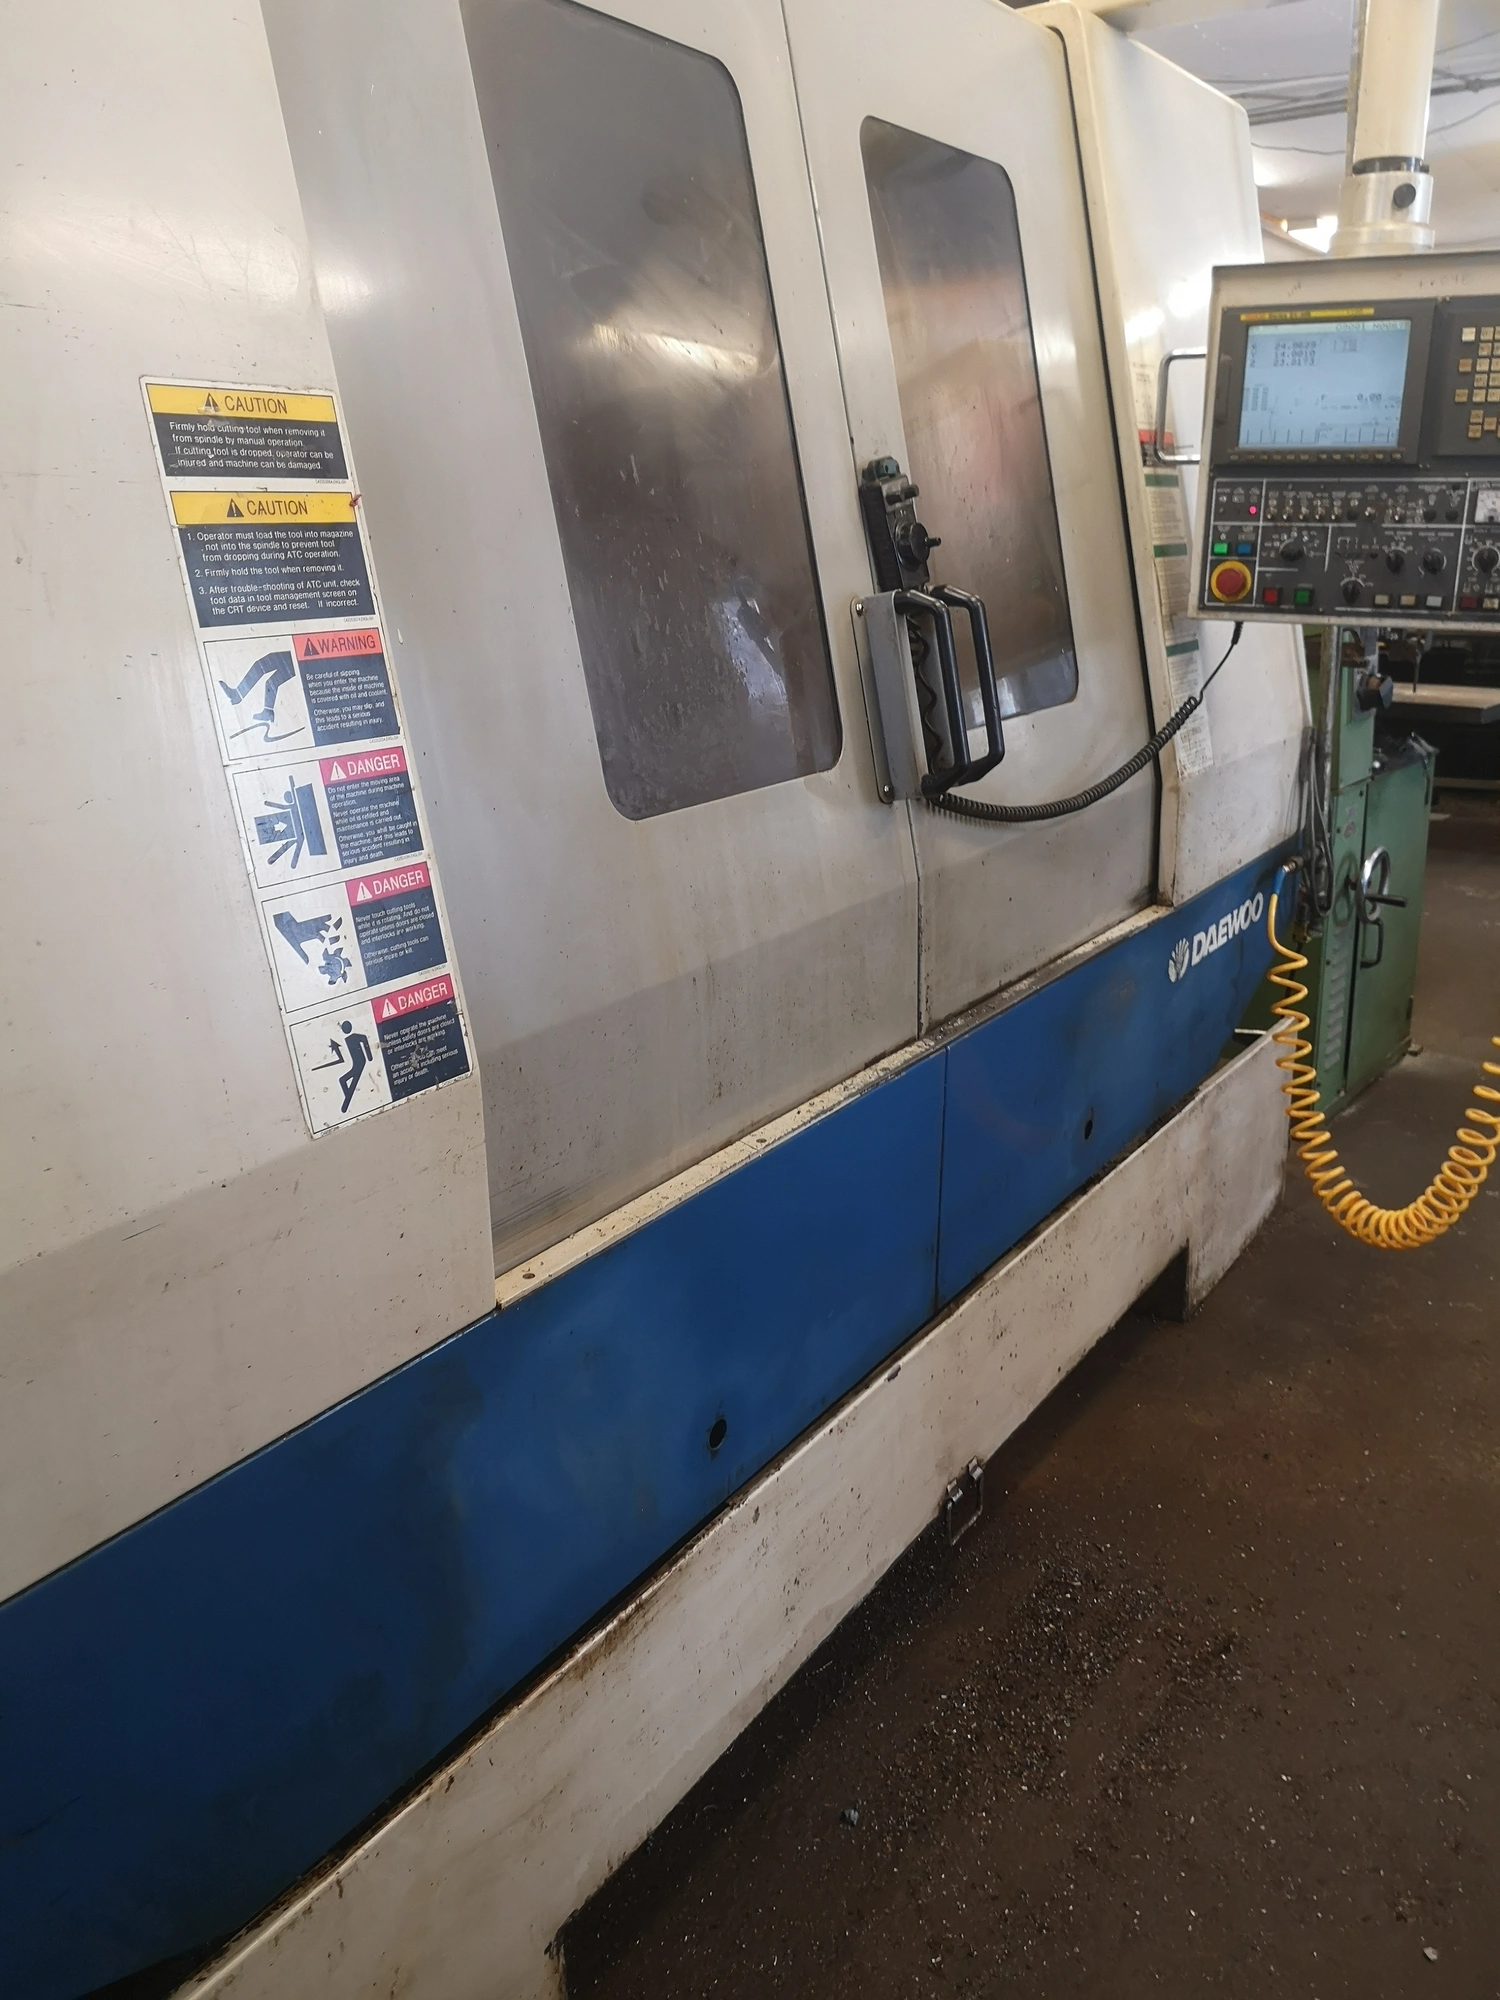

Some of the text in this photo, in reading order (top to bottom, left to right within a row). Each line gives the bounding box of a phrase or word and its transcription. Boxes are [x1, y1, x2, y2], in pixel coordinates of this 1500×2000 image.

[225, 396, 288, 414] CAUTION
[169, 422, 196, 432] Firmly
[197, 423, 216, 431] hold
[217, 424, 245, 434] cutting
[284, 428, 319, 438] removing
[172, 434, 306, 448] from spindle by manual operation.
[174, 446, 182, 454] If
[183, 447, 212, 456] cutting
[231, 448, 238, 456] is
[275, 450, 308, 459] operator
[177, 458, 207, 468] injured
[208, 459, 224, 467] and
[225, 459, 259, 467] machine
[287, 461, 323, 471] damaged.
[247, 500, 308, 516] CAUTION
[187, 533, 195, 541] 1.
[196, 532, 234, 542] Operator
[235, 532, 254, 540] must
[274, 531, 287, 539] the
[320, 530, 354, 539] magazine
[204, 543, 219, 551] not
[220, 542, 237, 550] into
[238, 542, 251, 550] the
[252, 541, 280, 551] spindle
[290, 540, 320, 549] prevent
[223, 552, 259, 562] dropping
[260, 551, 285, 561] during
[304, 550, 341, 559] operation.
[204, 569, 230, 579] Firmly
[231, 568, 249, 576] hold
[250, 567, 263, 575] the
[280, 566, 301, 574] when
[302, 564, 336, 574] removing
[198, 587, 207, 595] 3.
[208, 586, 229, 594] After
[230, 582, 295, 594] trouble-shooting
[306, 581, 322, 589] ATC
[339, 579, 360, 587] check
[210, 596, 227, 604] tool
[228, 595, 246, 603] data
[256, 594, 272, 602] tool
[273, 591, 321, 602] management
[212, 607, 226, 615] the
[227, 605, 244, 614] CRT
[246, 604, 271, 612] device
[272, 603, 288, 611] and
[288, 601, 310, 610] reset.
[318, 635, 375, 653] WARNING
[340, 669, 360, 677] slipping
[317, 723, 340, 731] accident
[340, 720, 362, 729] resulting
[347, 754, 400, 775] DANGER
[369, 778, 388, 787] moving
[345, 790, 367, 798] machine
[367, 787, 384, 795] during
[384, 783, 404, 791] machine
[343, 857, 358, 866] injury
[373, 870, 424, 894] DANGER
[356, 902, 416, 922] Never touch cutting tools
[357, 922, 371, 930] while
[1192, 892, 1263, 967] DAEWOO
[398, 983, 447, 1009] DANGER
[384, 1031, 399, 1040] Never
[399, 1024, 418, 1036] operate
